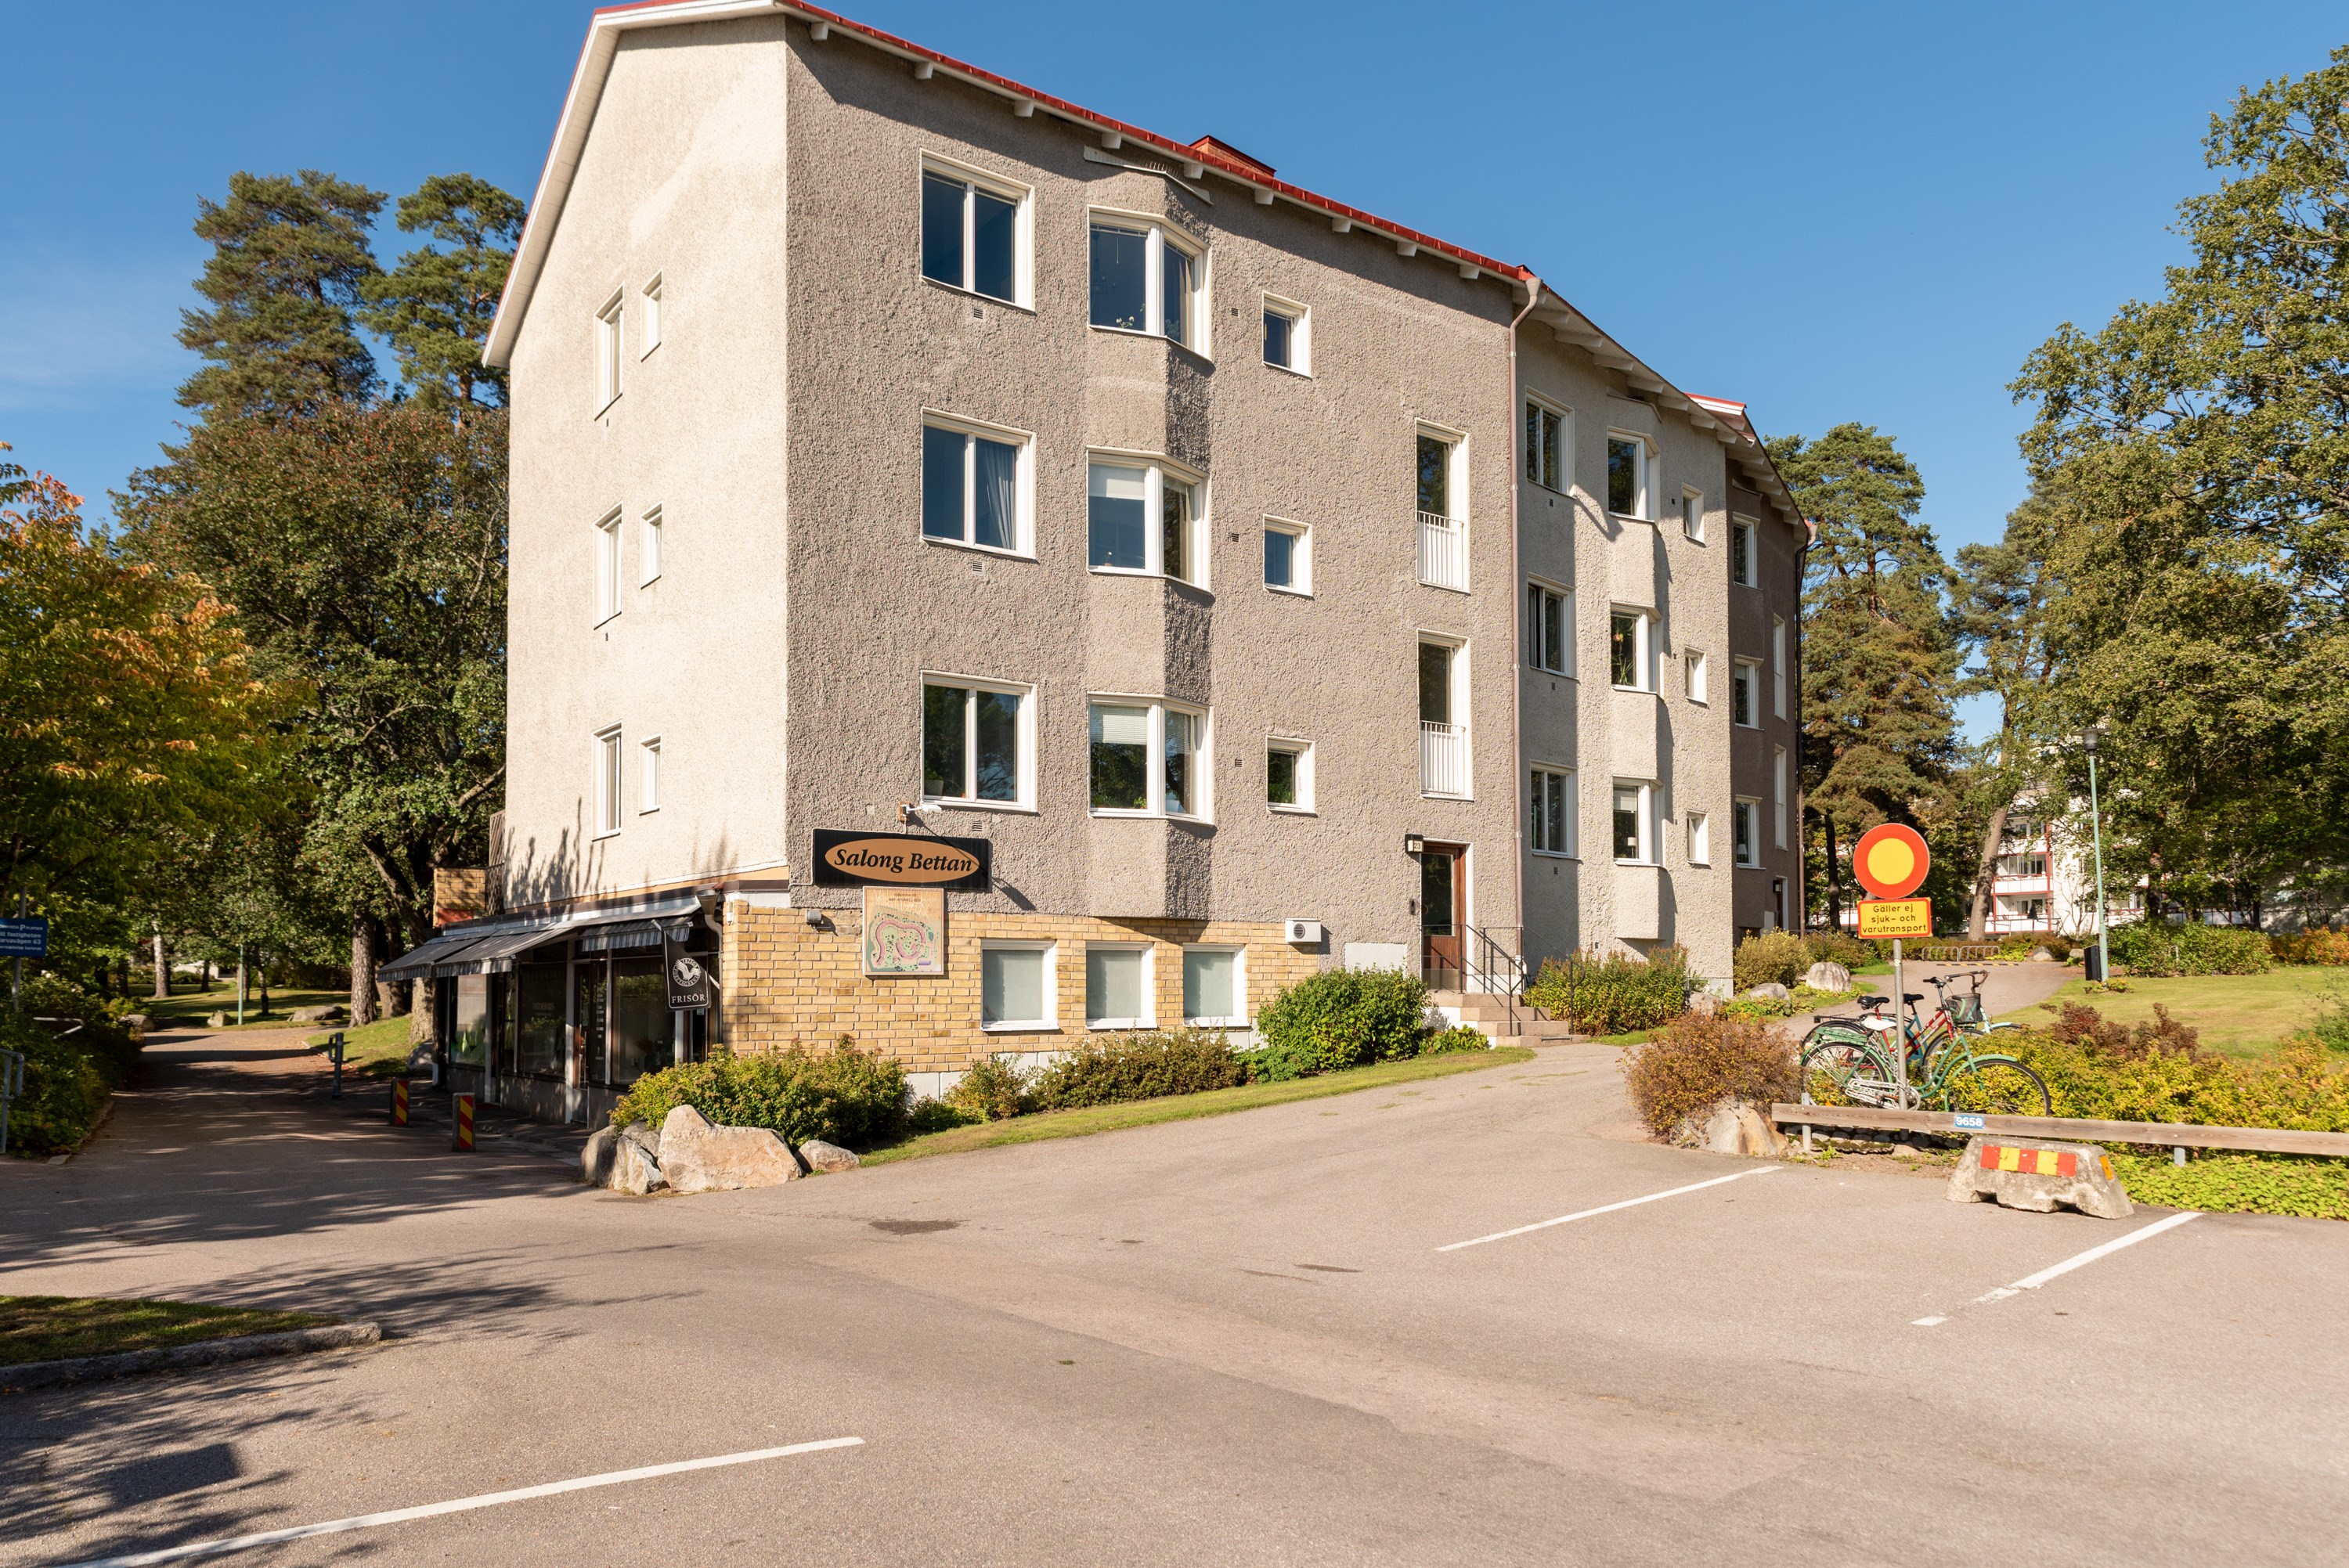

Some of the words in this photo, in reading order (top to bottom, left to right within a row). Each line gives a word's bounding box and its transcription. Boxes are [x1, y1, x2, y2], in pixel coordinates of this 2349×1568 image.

[834, 849, 904, 874] Salong
[908, 852, 972, 872] Bettan
[1904, 904, 1914, 913] ej
[1871, 915, 1896, 924] sjuk-
[1900, 914, 1916, 922] och
[1863, 924, 1926, 933] varutransport
[672, 993, 705, 1004] FRISÖR
[1956, 1117, 1983, 1126] 9658
